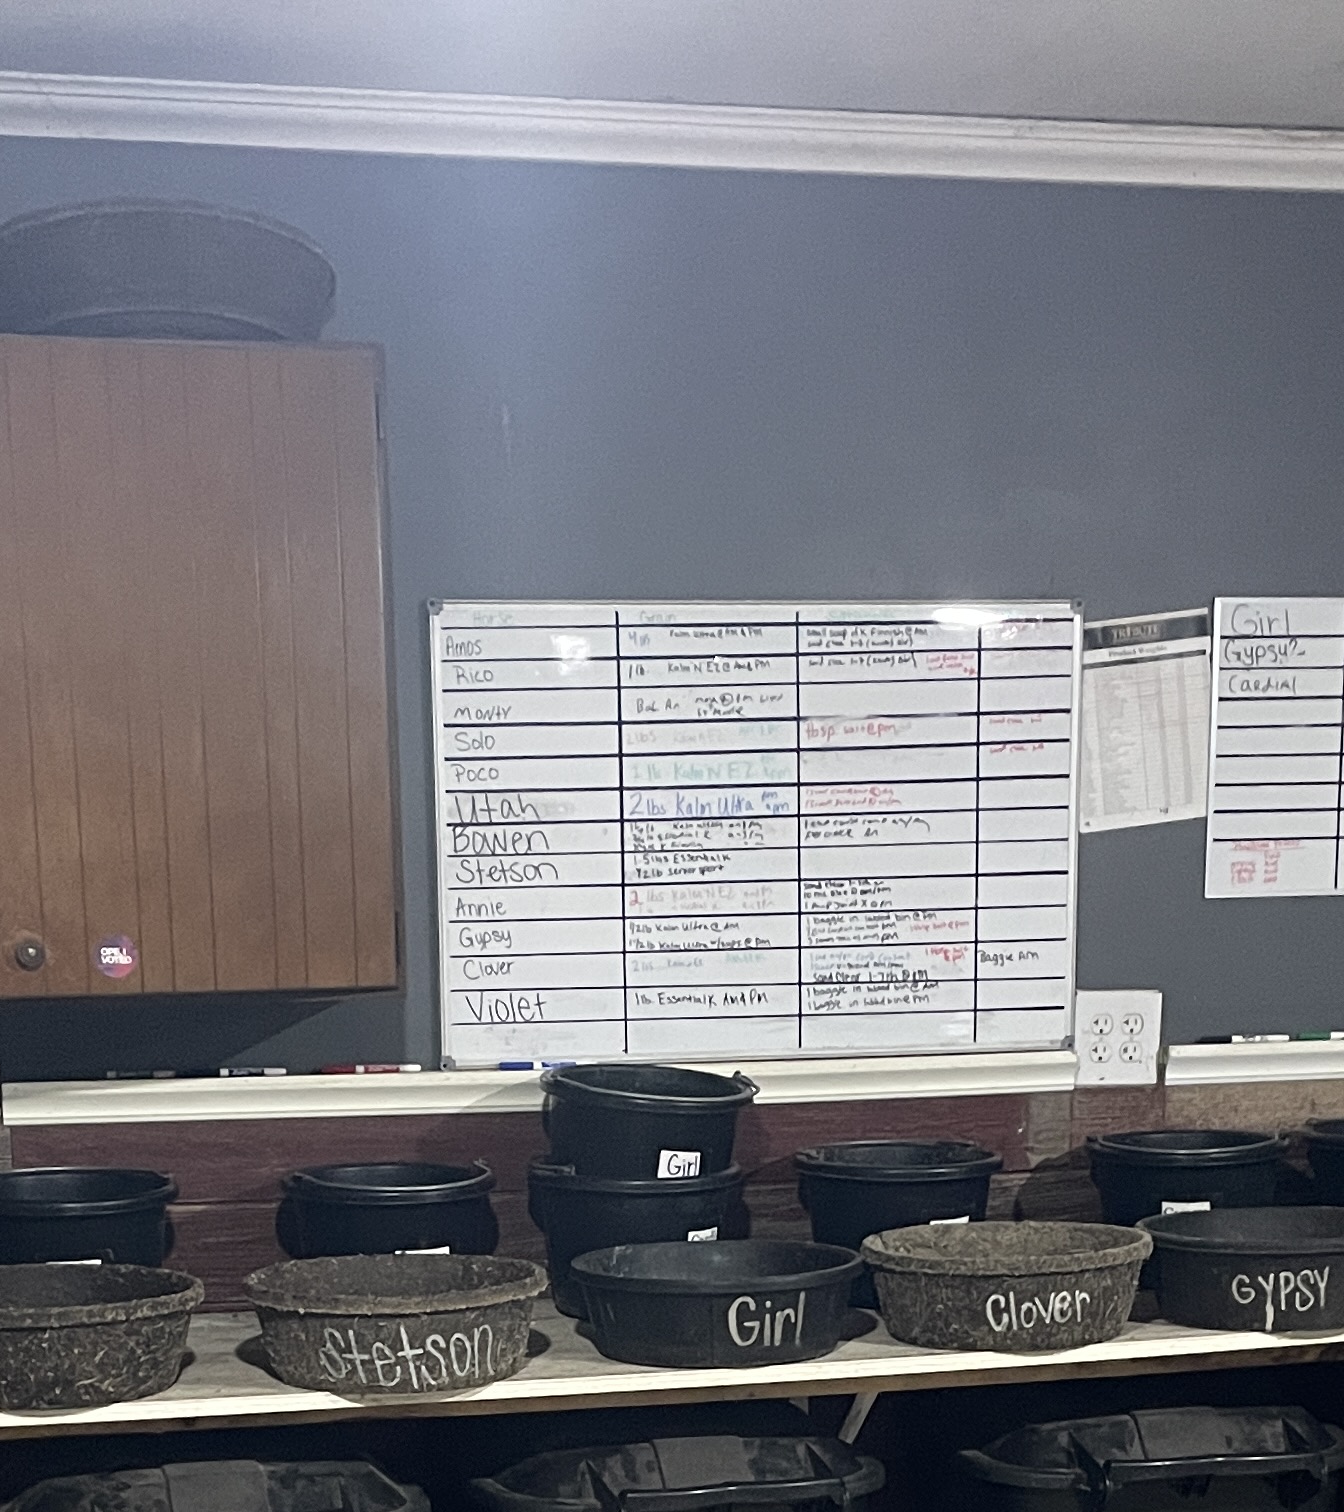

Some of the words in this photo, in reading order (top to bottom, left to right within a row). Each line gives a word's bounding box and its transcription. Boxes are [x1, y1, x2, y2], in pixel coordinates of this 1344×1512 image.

[1231, 603, 1290, 636] Girl
[446, 635, 482, 657] Amos
[453, 665, 494, 685] Rico
[455, 731, 495, 751] Solo
[450, 763, 499, 783] Poco
[455, 793, 541, 823] Utah
[629, 793, 644, 816] 2
[647, 799, 666, 816] lbs
[676, 792, 712, 816] Kalm
[456, 859, 559, 885] Stetson
[456, 897, 506, 918] Annie
[459, 927, 512, 951] Gypsy
[463, 960, 514, 980] Clover
[465, 991, 547, 1022] Violet
[667, 1154, 699, 1177] Girl
[985, 1288, 1091, 1334] Clover
[1232, 1266, 1332, 1333] GYPSY
[727, 1292, 806, 1349] Girl
[318, 1322, 498, 1390] Stetson
